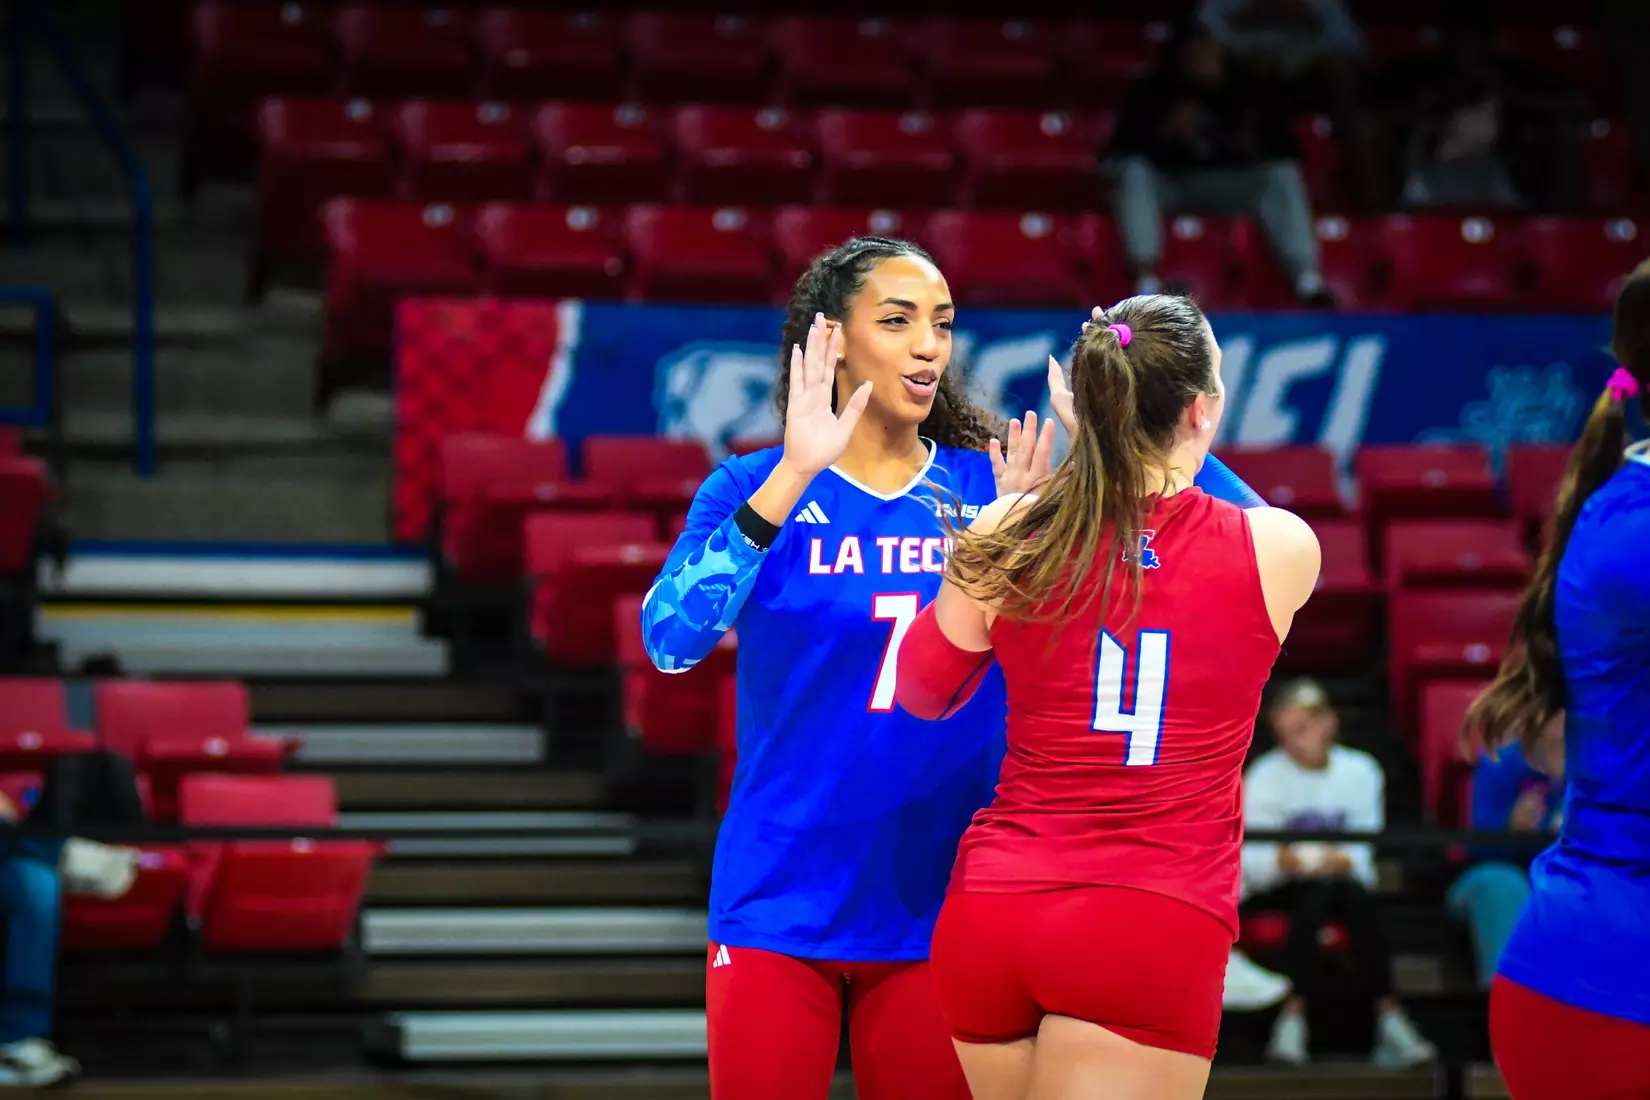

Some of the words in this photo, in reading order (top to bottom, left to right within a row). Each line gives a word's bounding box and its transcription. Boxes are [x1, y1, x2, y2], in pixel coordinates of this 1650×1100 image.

[809, 536, 864, 574] LA
[866, 591, 920, 713] 7
[1090, 626, 1171, 766] 4
